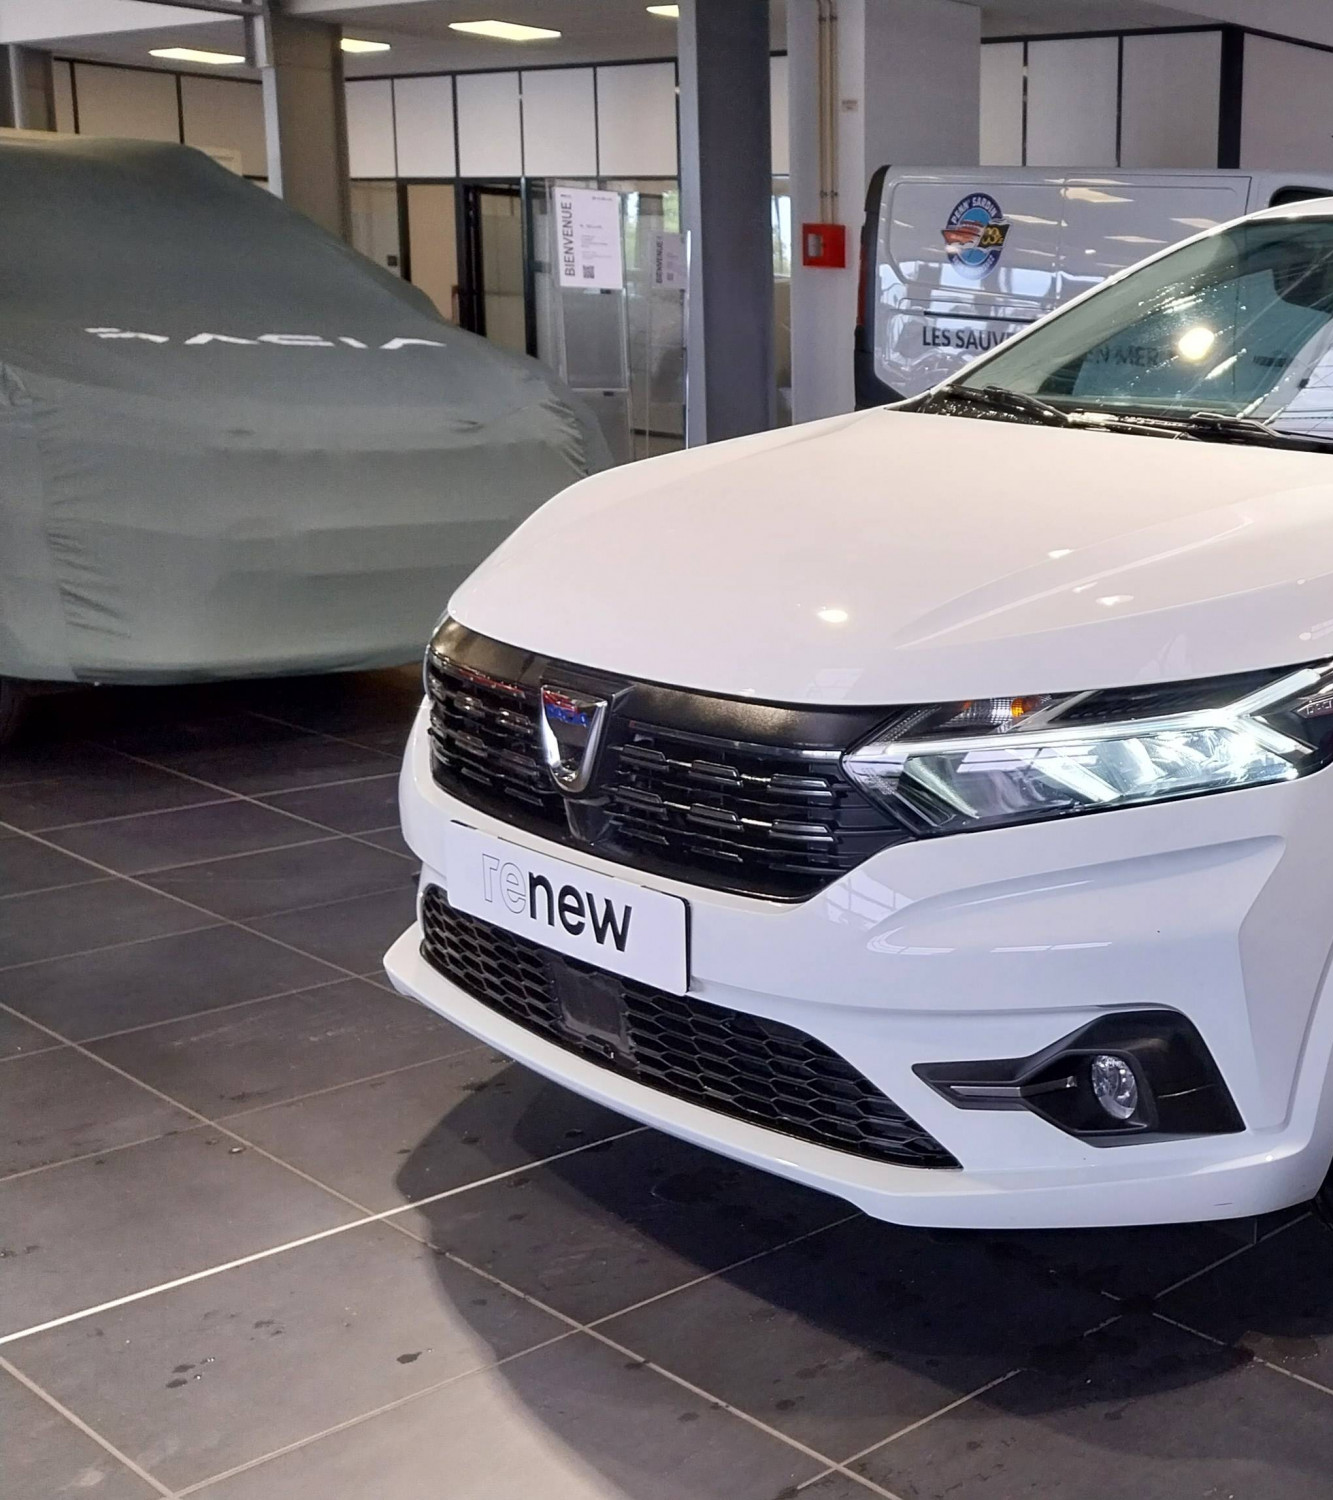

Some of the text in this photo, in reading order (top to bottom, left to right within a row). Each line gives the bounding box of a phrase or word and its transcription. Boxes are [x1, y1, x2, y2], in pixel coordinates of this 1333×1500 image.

[560, 201, 576, 277] BIENVENUE
[922, 326, 951, 347] LES
[482, 853, 633, 953] renew
